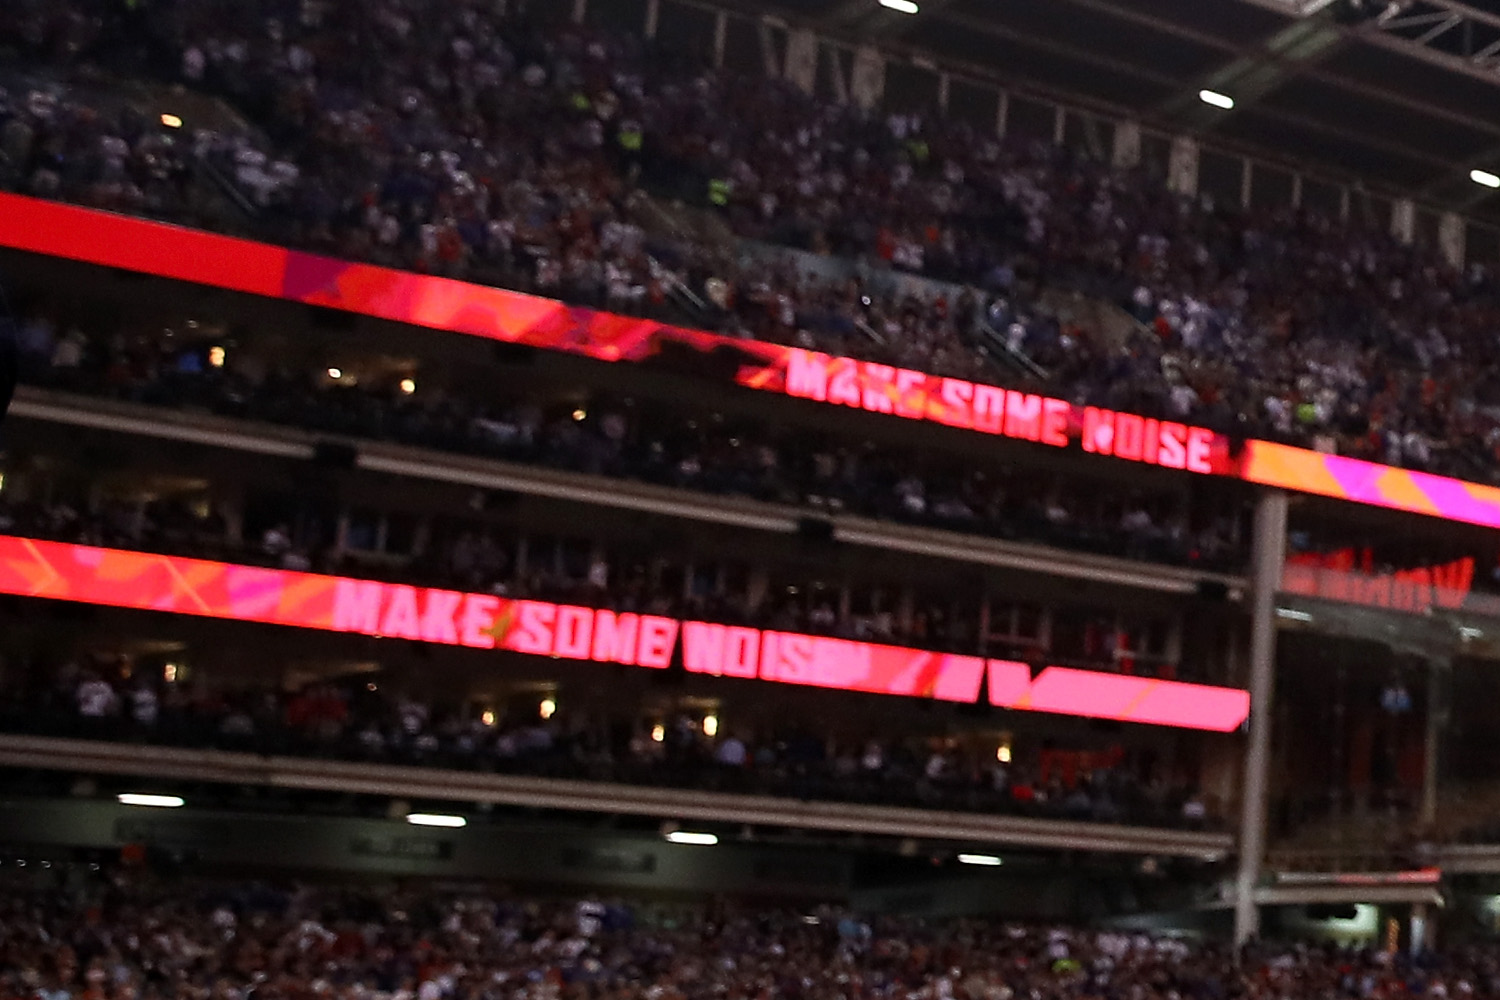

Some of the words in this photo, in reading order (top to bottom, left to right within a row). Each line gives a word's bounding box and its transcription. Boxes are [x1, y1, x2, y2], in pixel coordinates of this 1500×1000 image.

[787, 347, 926, 419] MAKE
[941, 377, 1070, 447] SOME
[1081, 406, 1214, 474] NOISE
[334, 579, 499, 649] MAKE
[508, 599, 679, 668] SOME
